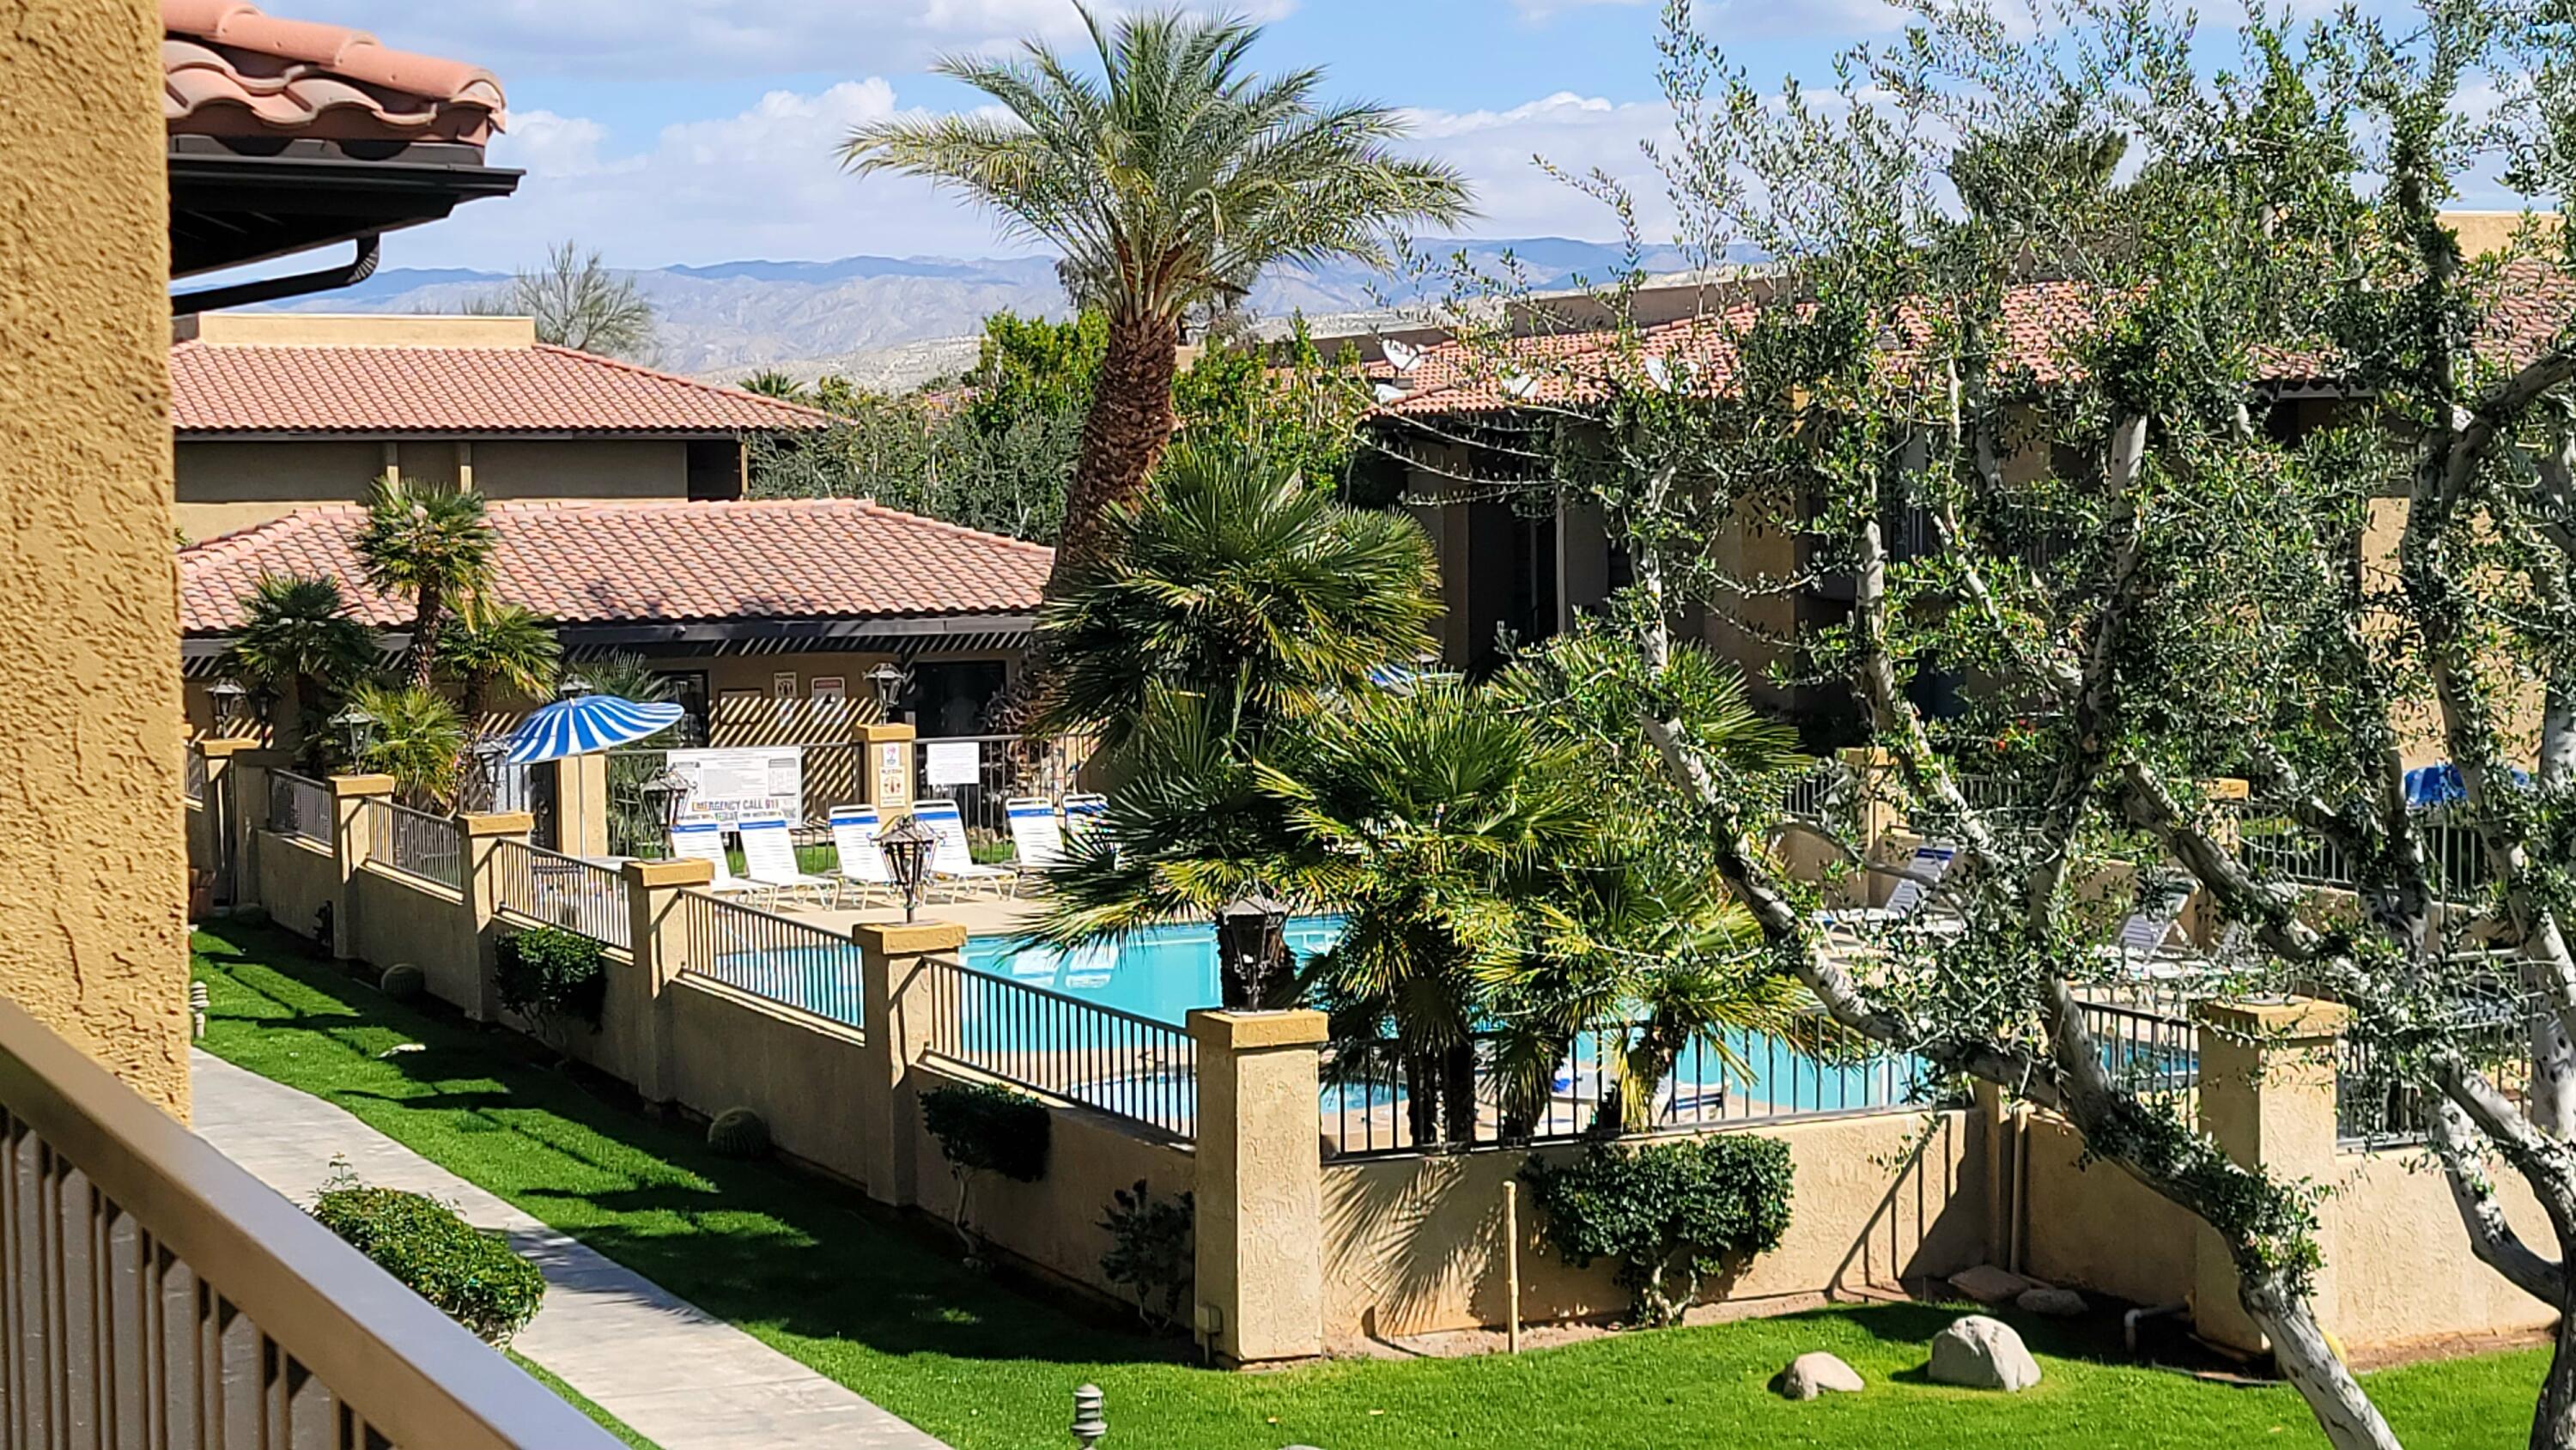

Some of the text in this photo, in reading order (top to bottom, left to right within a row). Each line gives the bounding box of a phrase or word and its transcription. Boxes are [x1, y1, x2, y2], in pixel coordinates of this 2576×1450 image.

[691, 800, 740, 811] EMERGENCY
[743, 799, 762, 810] CALL
[765, 798, 779, 809] 911
